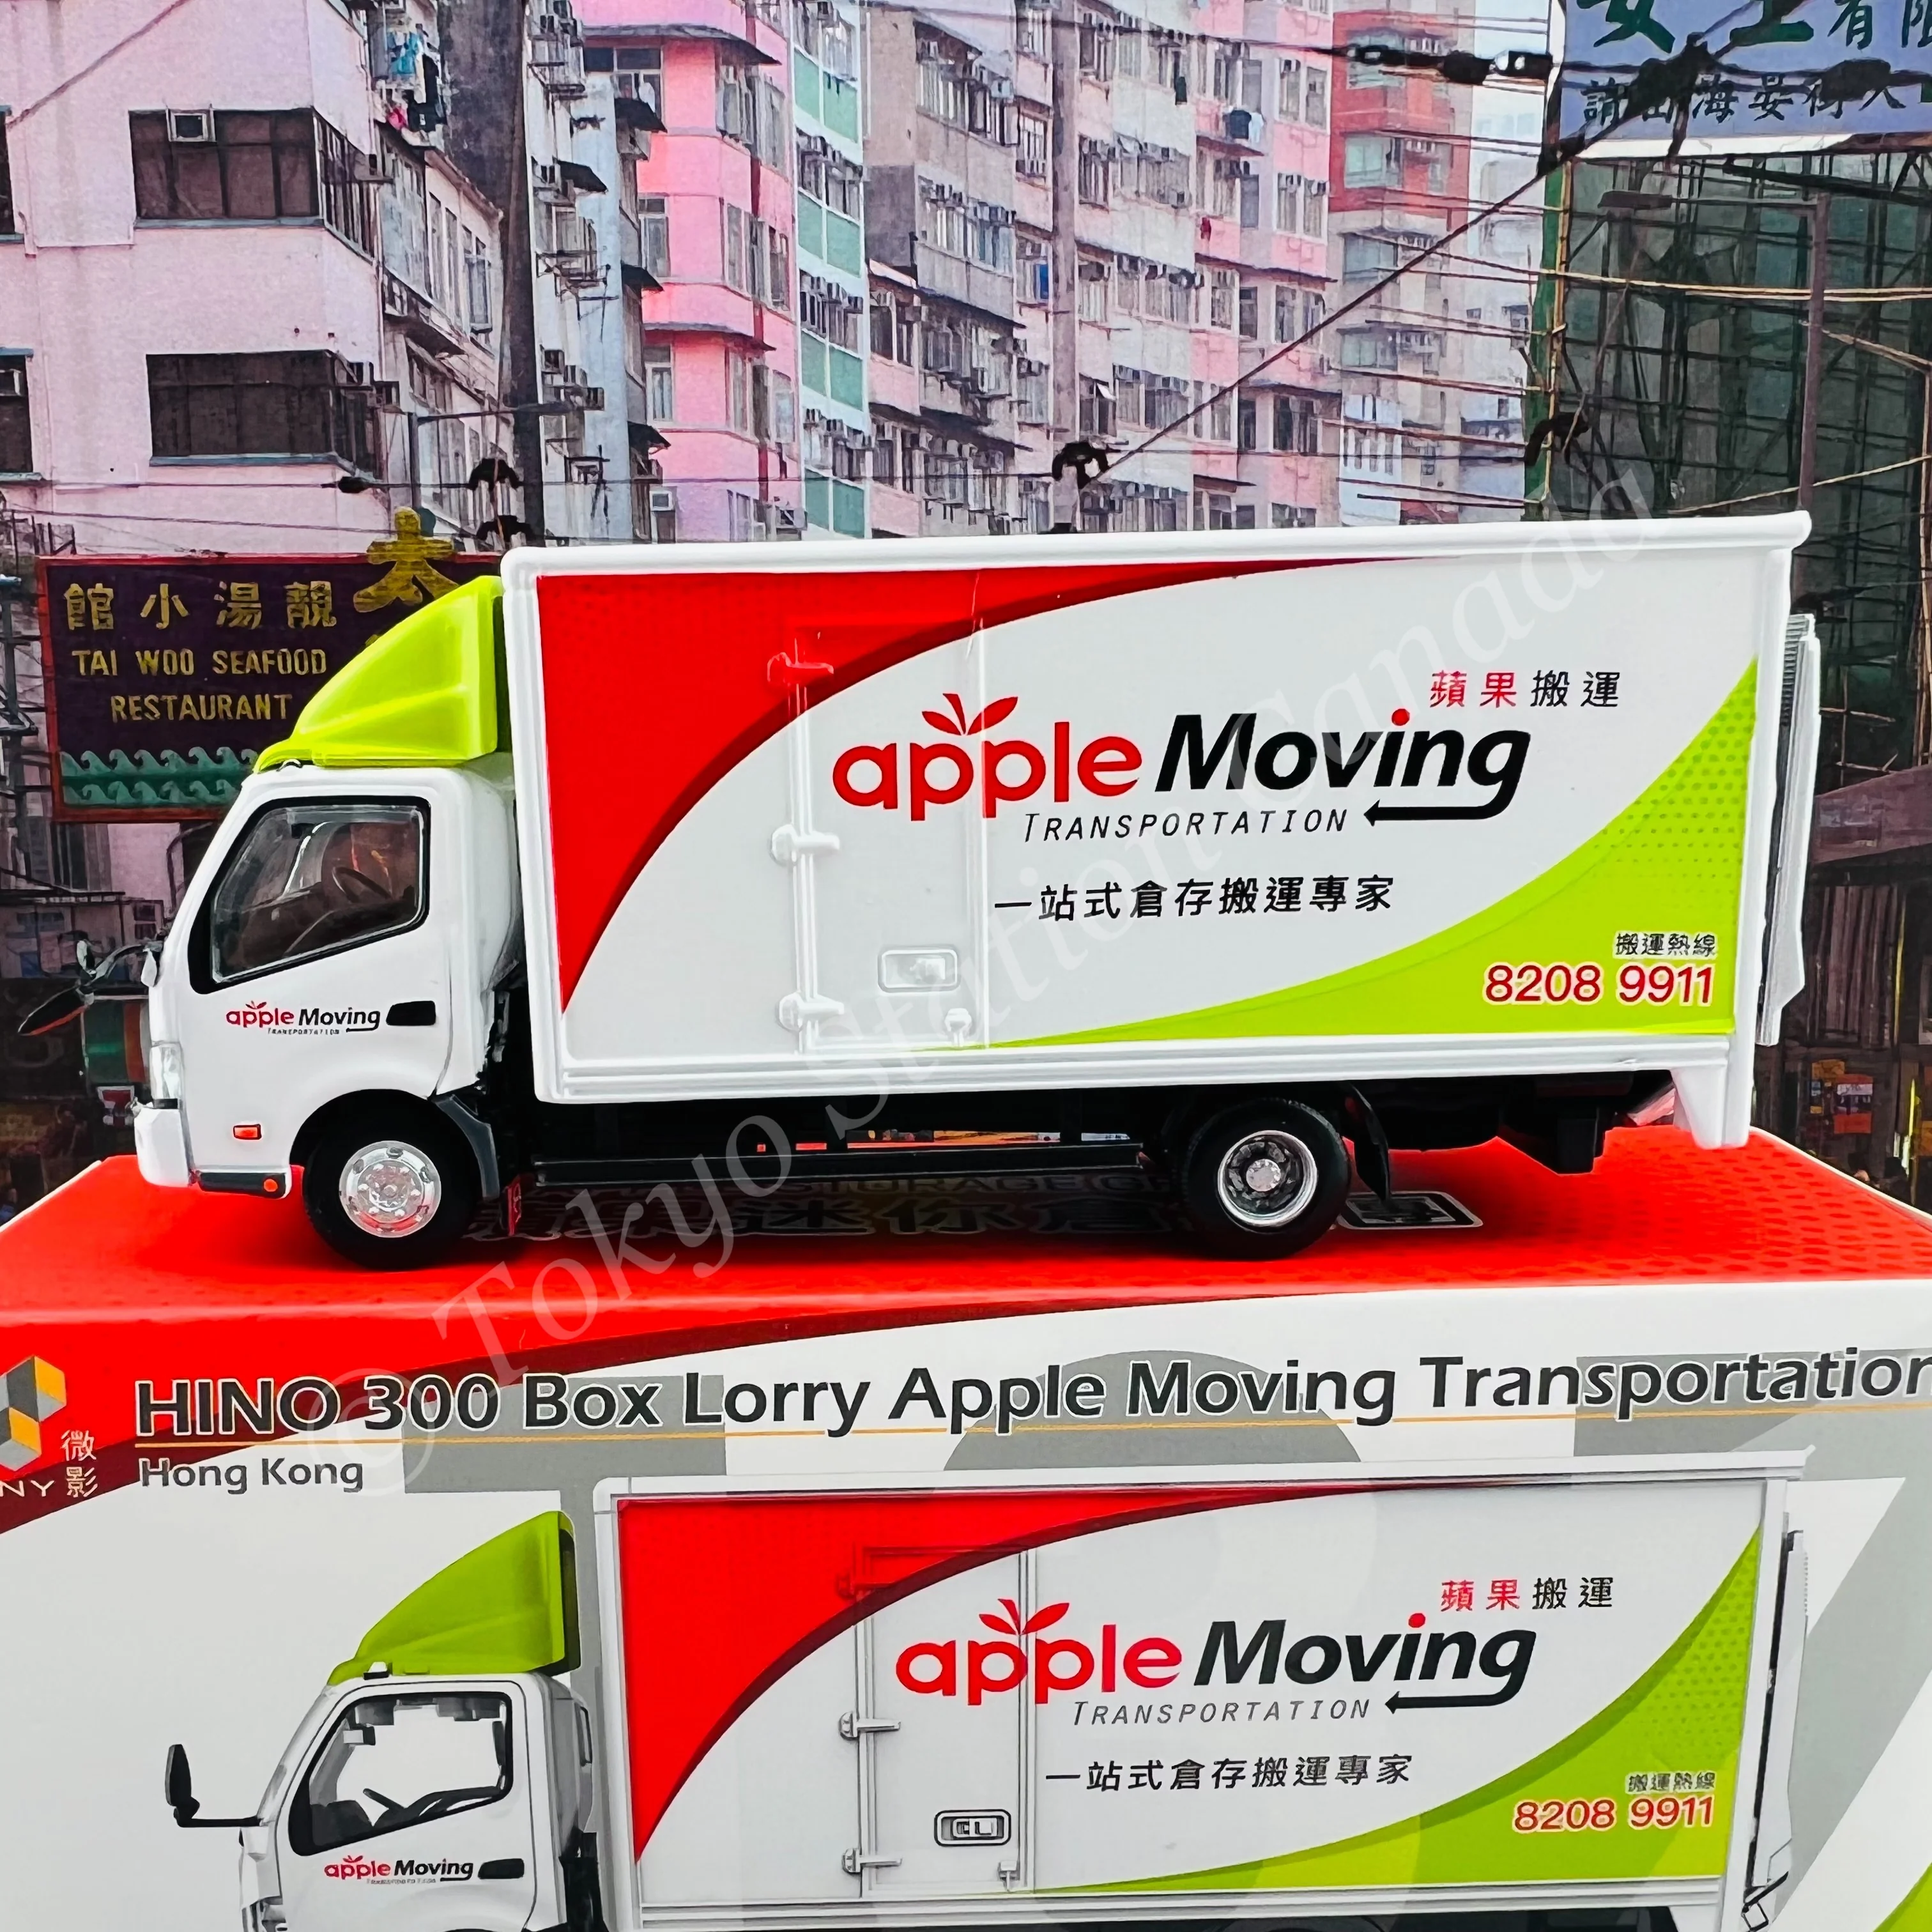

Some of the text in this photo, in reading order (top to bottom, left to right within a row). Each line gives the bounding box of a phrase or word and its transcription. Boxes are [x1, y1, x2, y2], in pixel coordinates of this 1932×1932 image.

[72, 648, 327, 677] TAI WOO SEAFOOD
[1429, 669, 1621, 709] 蘋果搬運
[111, 693, 293, 723] RESTAURANT
[832, 707, 1532, 823] apple Moving
[1023, 806, 1348, 843] TRANSPORTATION
[993, 874, 1394, 922] 一站式倉存搬運專家
[1616, 932, 1717, 956] 搬運熱線
[1484, 963, 1713, 1004] 8208 9911
[226, 1006, 381, 1033] apple Moving
[135, 1346, 1932, 1438] HINO 300 Box Lorry Apple Moving Transportation
[139, 1456, 364, 1495] Hong Kong
[1441, 1576, 1614, 1612] 蘋果搬運
[895, 1612, 1537, 1710] apple Moving
[1073, 1698, 1372, 1727] TRANSPORTATION
[1045, 1752, 1413, 1792] 一站式倉存搬運專家
[1514, 1796, 1715, 1832] 8208 9911
[324, 1858, 474, 1882] apple Moving
